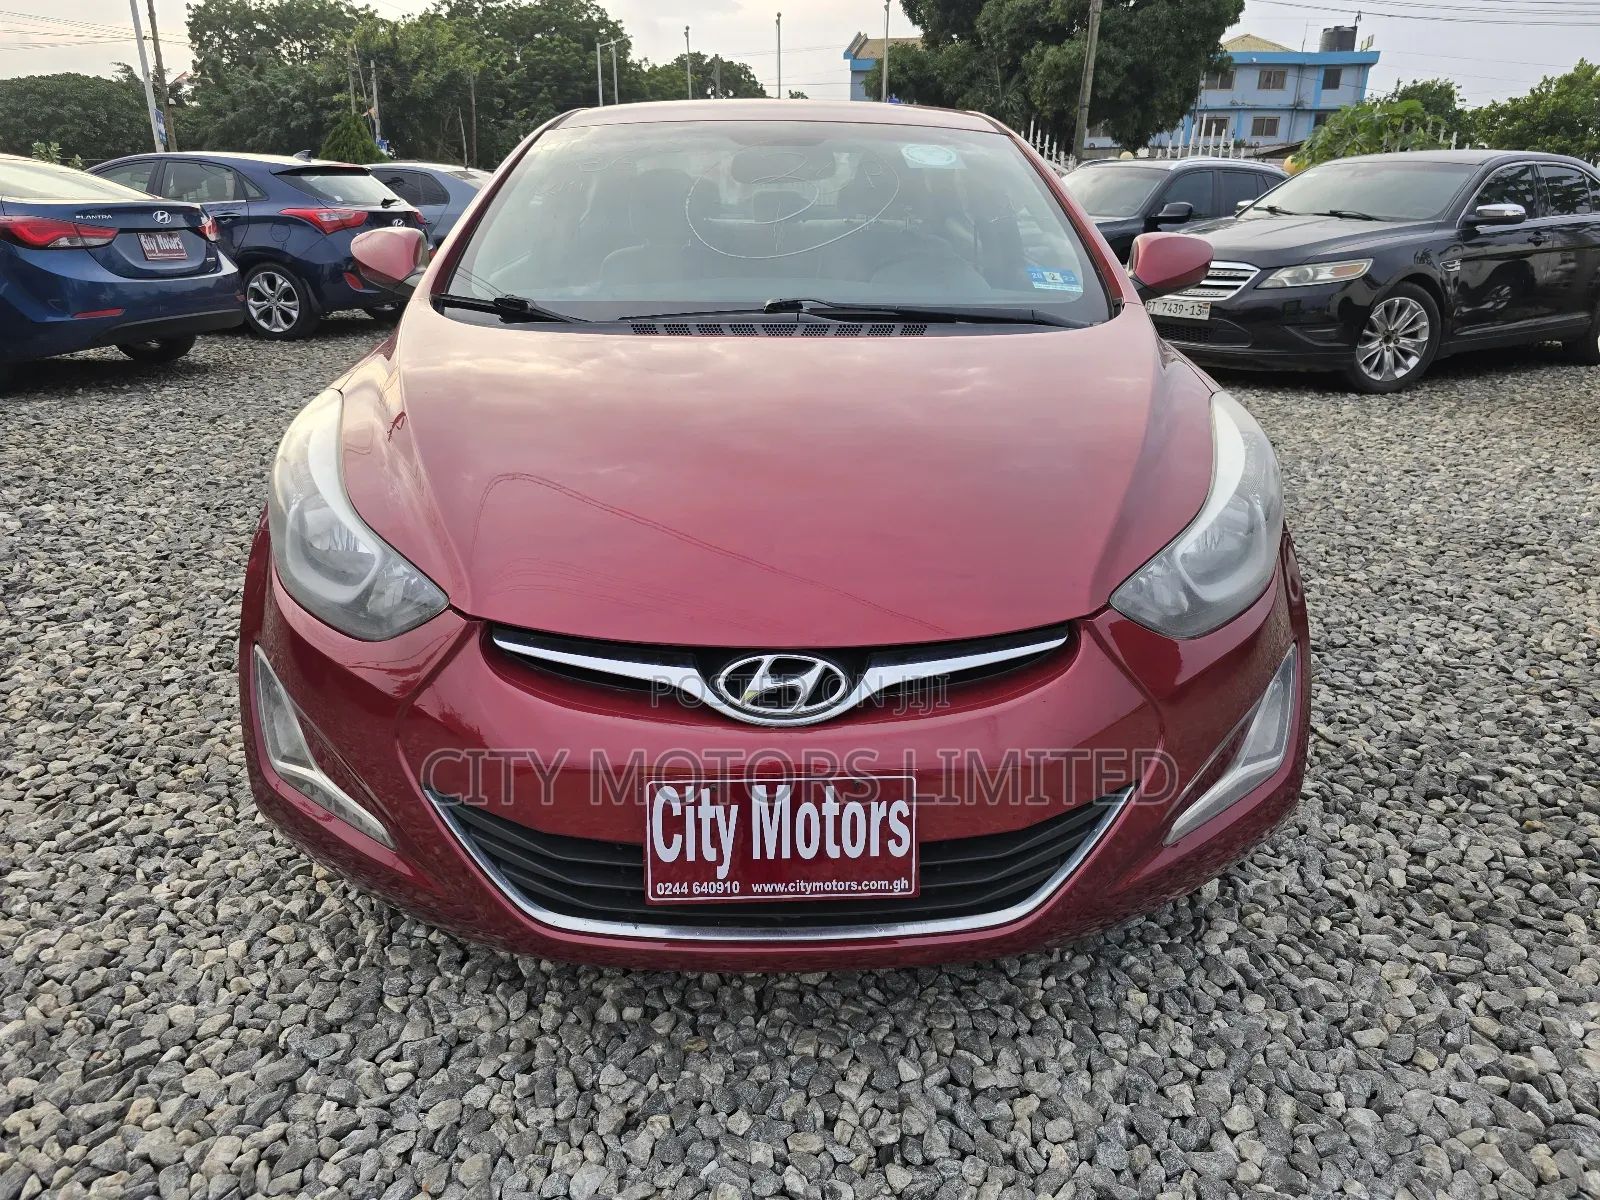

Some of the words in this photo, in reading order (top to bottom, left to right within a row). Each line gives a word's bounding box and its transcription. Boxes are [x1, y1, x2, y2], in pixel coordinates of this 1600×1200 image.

[140, 234, 158, 253] City
[157, 234, 185, 250] Motors
[1162, 302, 1203, 316] 7439-13
[652, 784, 738, 879] City
[751, 784, 911, 861] Motors
[656, 881, 689, 895] 0244
[692, 881, 740, 895] 640910
[752, 877, 909, 895] www.citymotors.com.gh
